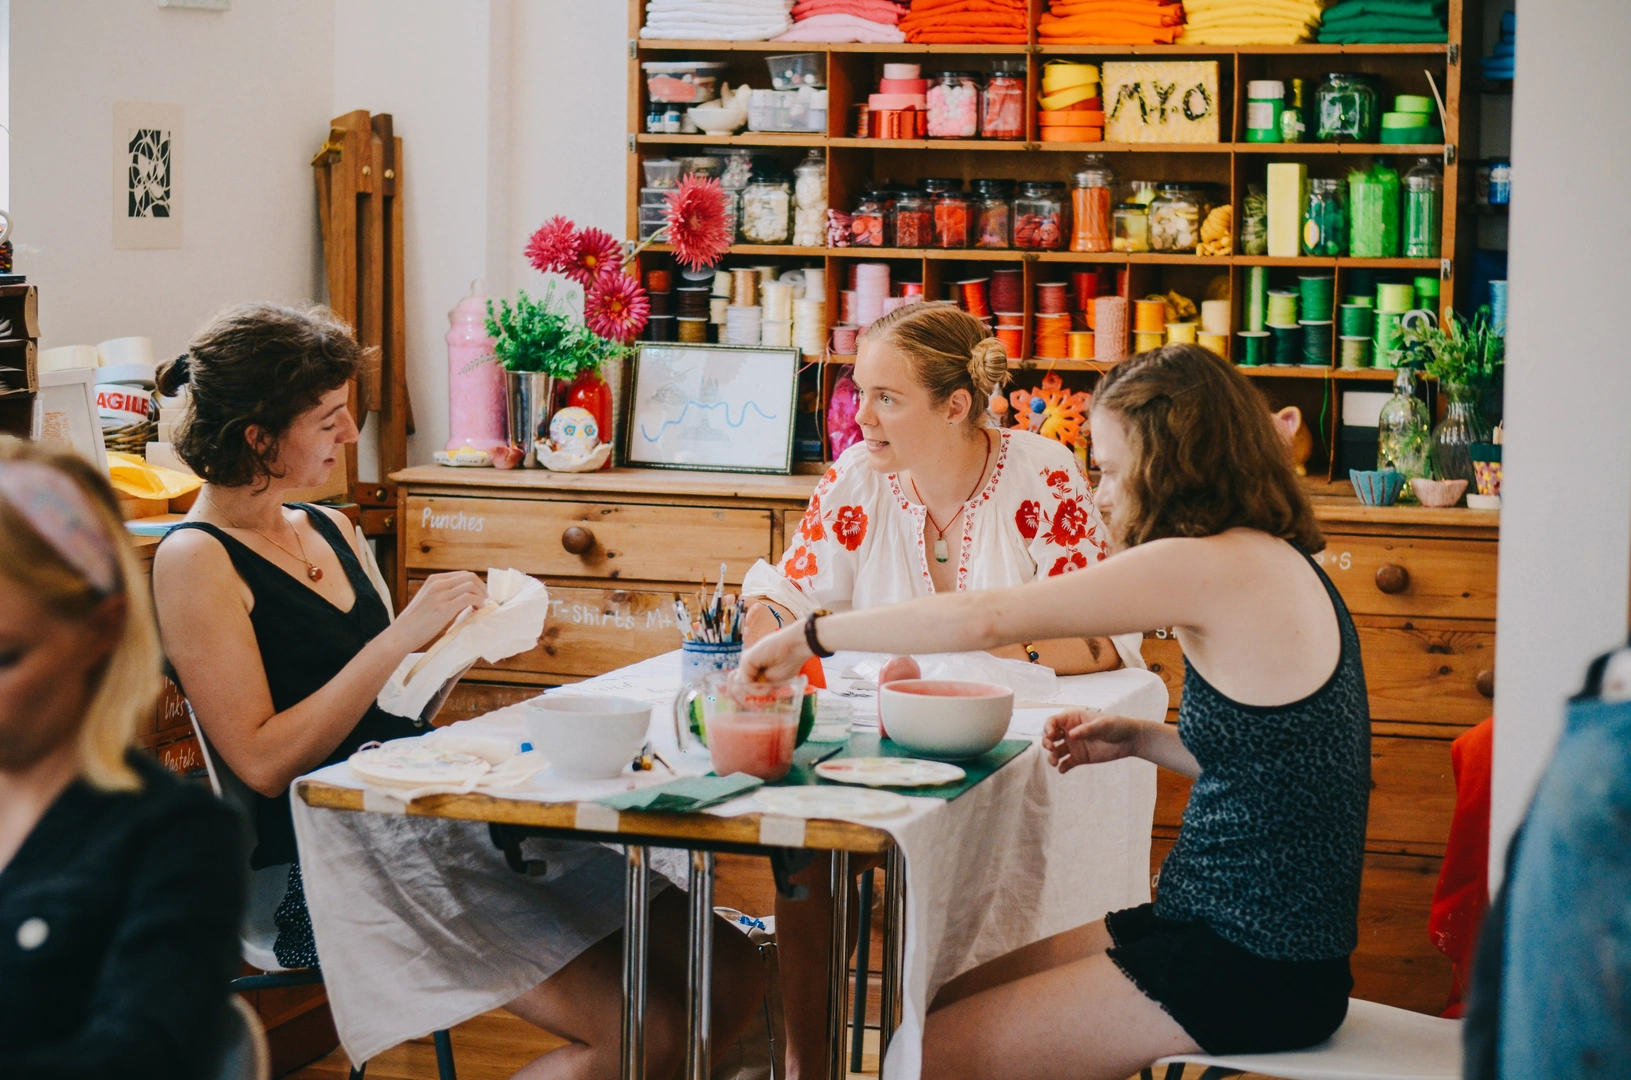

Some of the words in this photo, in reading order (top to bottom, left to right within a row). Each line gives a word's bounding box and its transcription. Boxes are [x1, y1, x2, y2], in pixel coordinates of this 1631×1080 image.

[421, 506, 486, 532] Punches
[549, 599, 635, 630] T-Shirts
[165, 694, 185, 720] Inks
